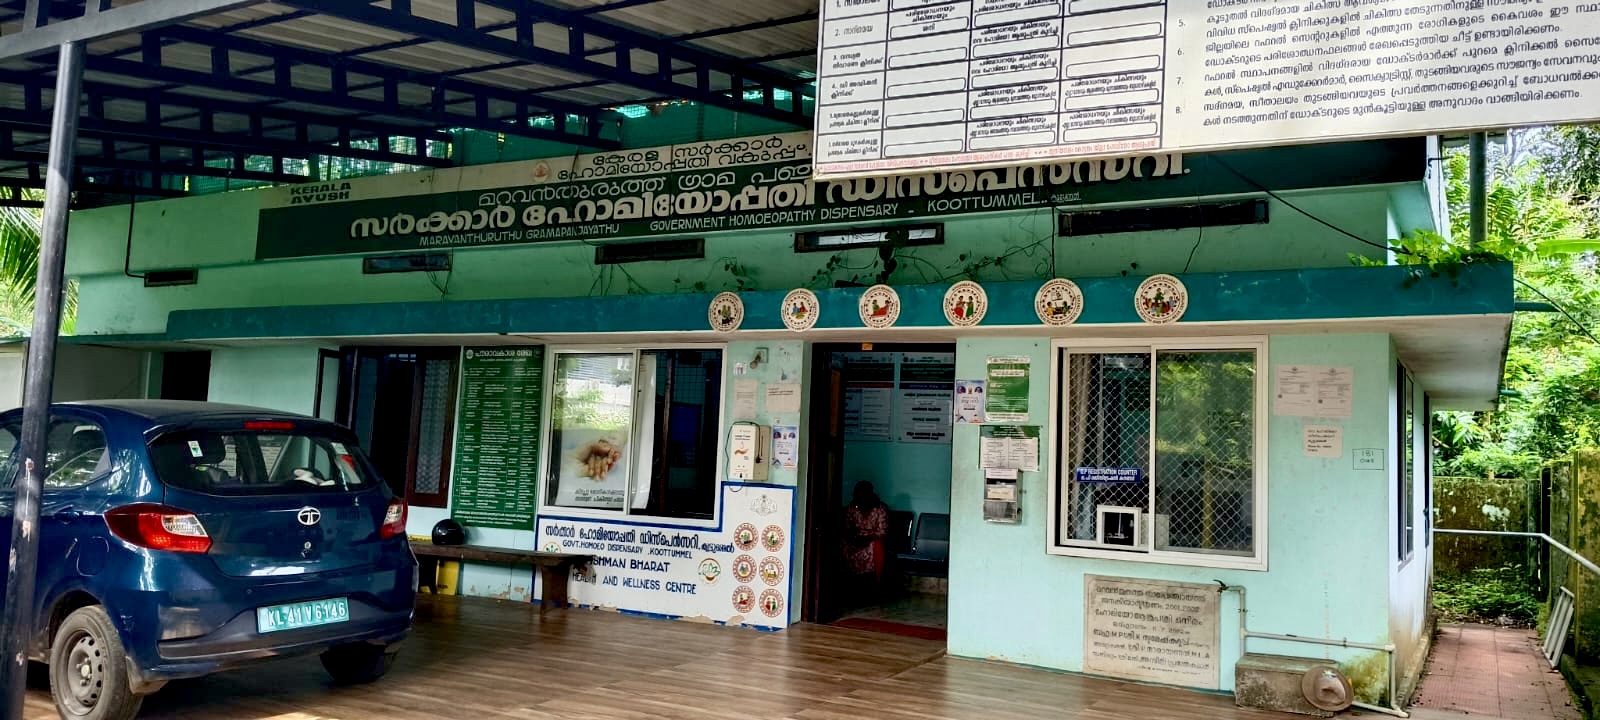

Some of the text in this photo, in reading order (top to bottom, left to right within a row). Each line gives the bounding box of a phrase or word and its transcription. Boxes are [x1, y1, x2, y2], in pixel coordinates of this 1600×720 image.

[1177, 48, 1186, 56] 6.
[1206, 40, 1249, 52] ജില്ലയിലെ
[1255, 34, 1286, 46] റഫറൽ
[1366, 23, 1412, 36] എത്തുന്ന
[1419, 15, 1485, 29] രോഗികളുടെ
[1491, 10, 1543, 21] കൈവശം
[1550, 7, 1568, 18] ഈ
[1178, 19, 1187, 28] 5.
[1207, 27, 1235, 38] വിവിധ
[1238, 20, 1286, 34] സ്പെഷ്യൽ
[1289, 11, 1360, 31] ക്ലിനിക്കുകളിൽ
[1363, 8, 1402, 20] ചികിത്സ
[1205, 51, 1261, 67] ഡോക്ടറുടെ
[1369, 33, 1449, 50] രേഖപ്പെടുത്തിയ
[1452, 30, 1472, 43] ചീട്ട്
[1176, 77, 1185, 86] 7.
[1205, 70, 1235, 81] റഫറൽ
[1241, 62, 1313, 78] സ്ഥാപനങ്ങളിൽ
[1377, 48, 1457, 65] ഡോക്ടർമാർക്ക്
[1463, 47, 1497, 58] പുറമെ
[1504, 39, 1558, 56] ക്ലിനിക്കൽ
[1415, 63, 1494, 79] തുടങ്ങിയവരുടെ
[1175, 107, 1183, 115] 8.
[1249, 96, 1298, 107] സീതാലയം
[1303, 89, 1385, 104] തുടങ്ങിയവയുടെ
[1203, 115, 1221, 126] കൾ
[1223, 110, 1288, 124] നടത്തുന്നതിന്
[1290, 107, 1350, 119] ഡോക്ടറുടെ
[1353, 101, 1426, 116] മുൻകൂട്ടിയുള്ള
[1429, 97, 1483, 109] അനുവാദം
[674, 136, 783, 158] സർക്കാർ
[557, 155, 709, 180] ഹോമിയോപ്പതി
[290, 182, 351, 195] KERALA
[291, 192, 350, 204] AYUSH
[351, 206, 516, 238] സർക്കാർ
[521, 179, 815, 227] ഹോമിയോപ്പതി
[420, 231, 523, 247] MARAVANTHURUTHU
[649, 216, 726, 231] GOVERNMENT
[729, 208, 817, 226] HOMOEOPATHY
[820, 203, 899, 221] DISPENSARY
[608, 545, 644, 553] DISPENSARY
[630, 559, 670, 573] BHARAT
[602, 576, 618, 585] AND
[623, 577, 661, 590] WELLNESS
[665, 581, 697, 594] CENTRE
[287, 607, 302, 622] 41
[305, 605, 312, 620] V
[314, 602, 346, 620] 6146
